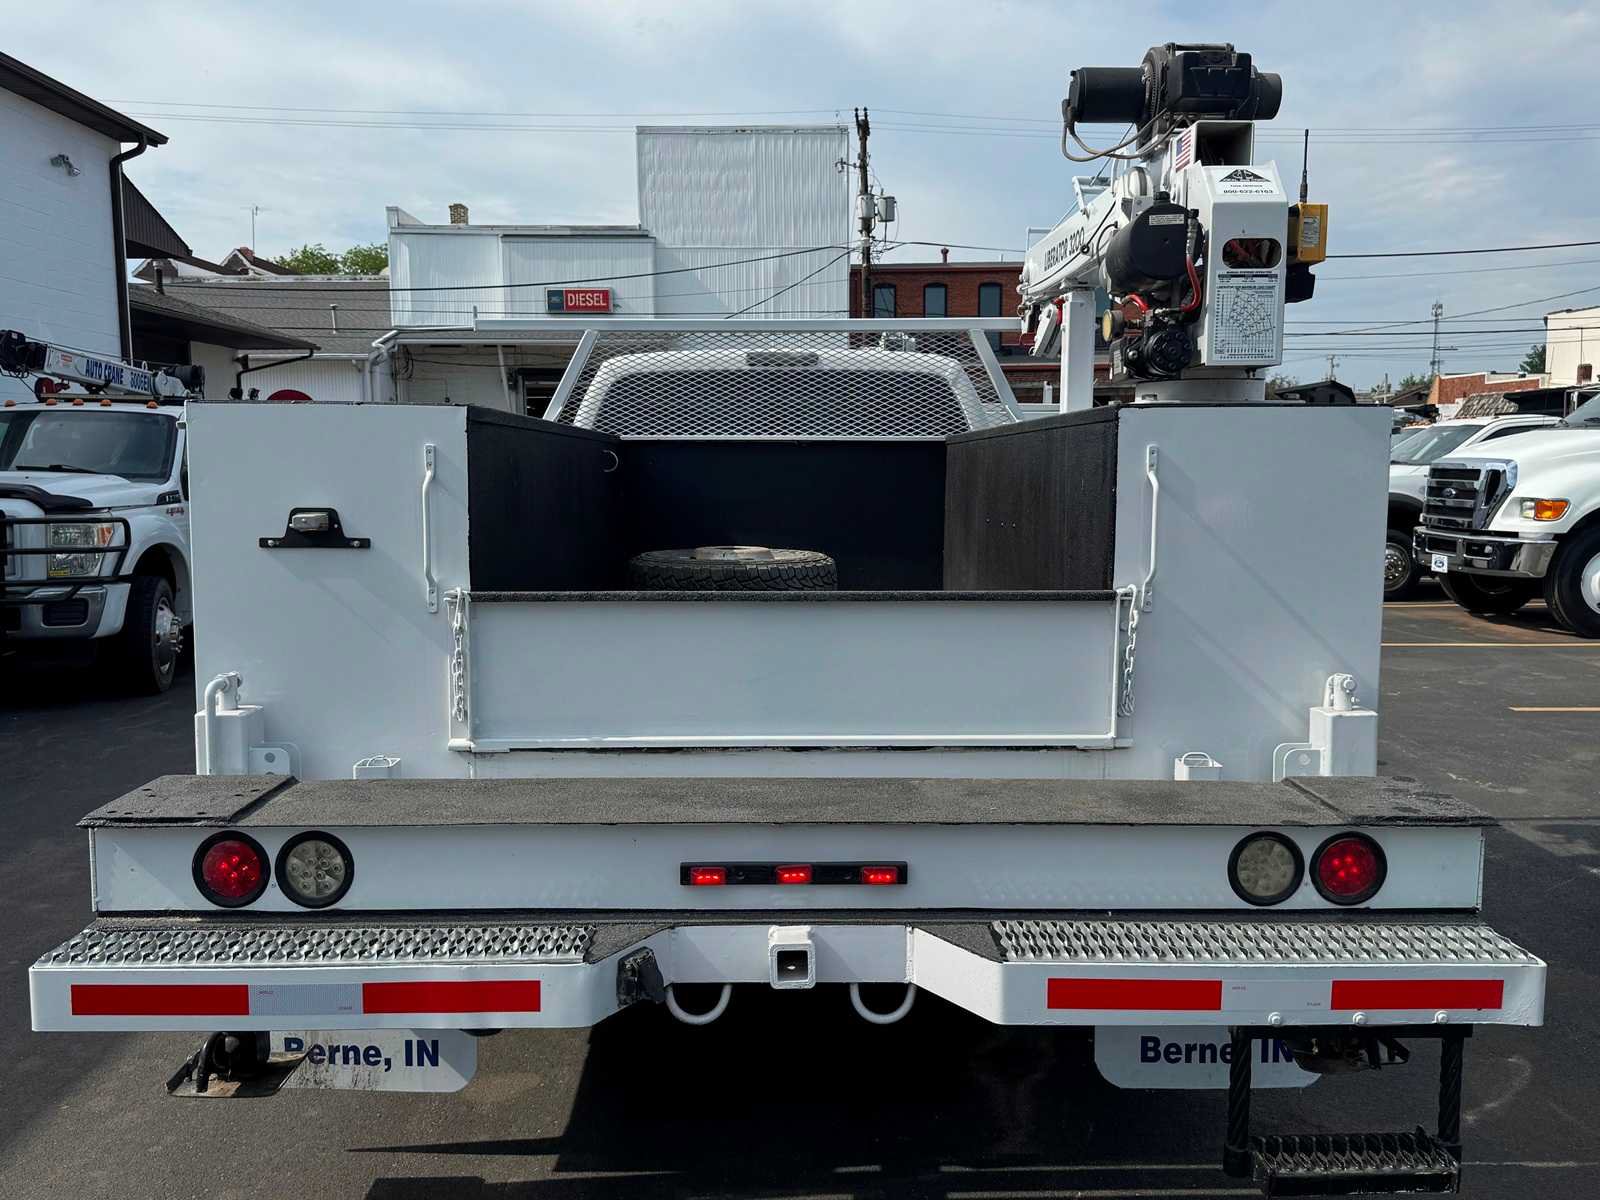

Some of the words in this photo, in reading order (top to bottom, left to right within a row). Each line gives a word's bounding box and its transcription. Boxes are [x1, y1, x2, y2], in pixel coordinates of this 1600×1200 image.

[1043, 237, 1068, 271] LIBERATOR
[567, 293, 607, 306] DIESEL
[85, 359, 102, 379] AUTO
[104, 364, 124, 384] CRANE
[404, 1040, 439, 1066] IN
